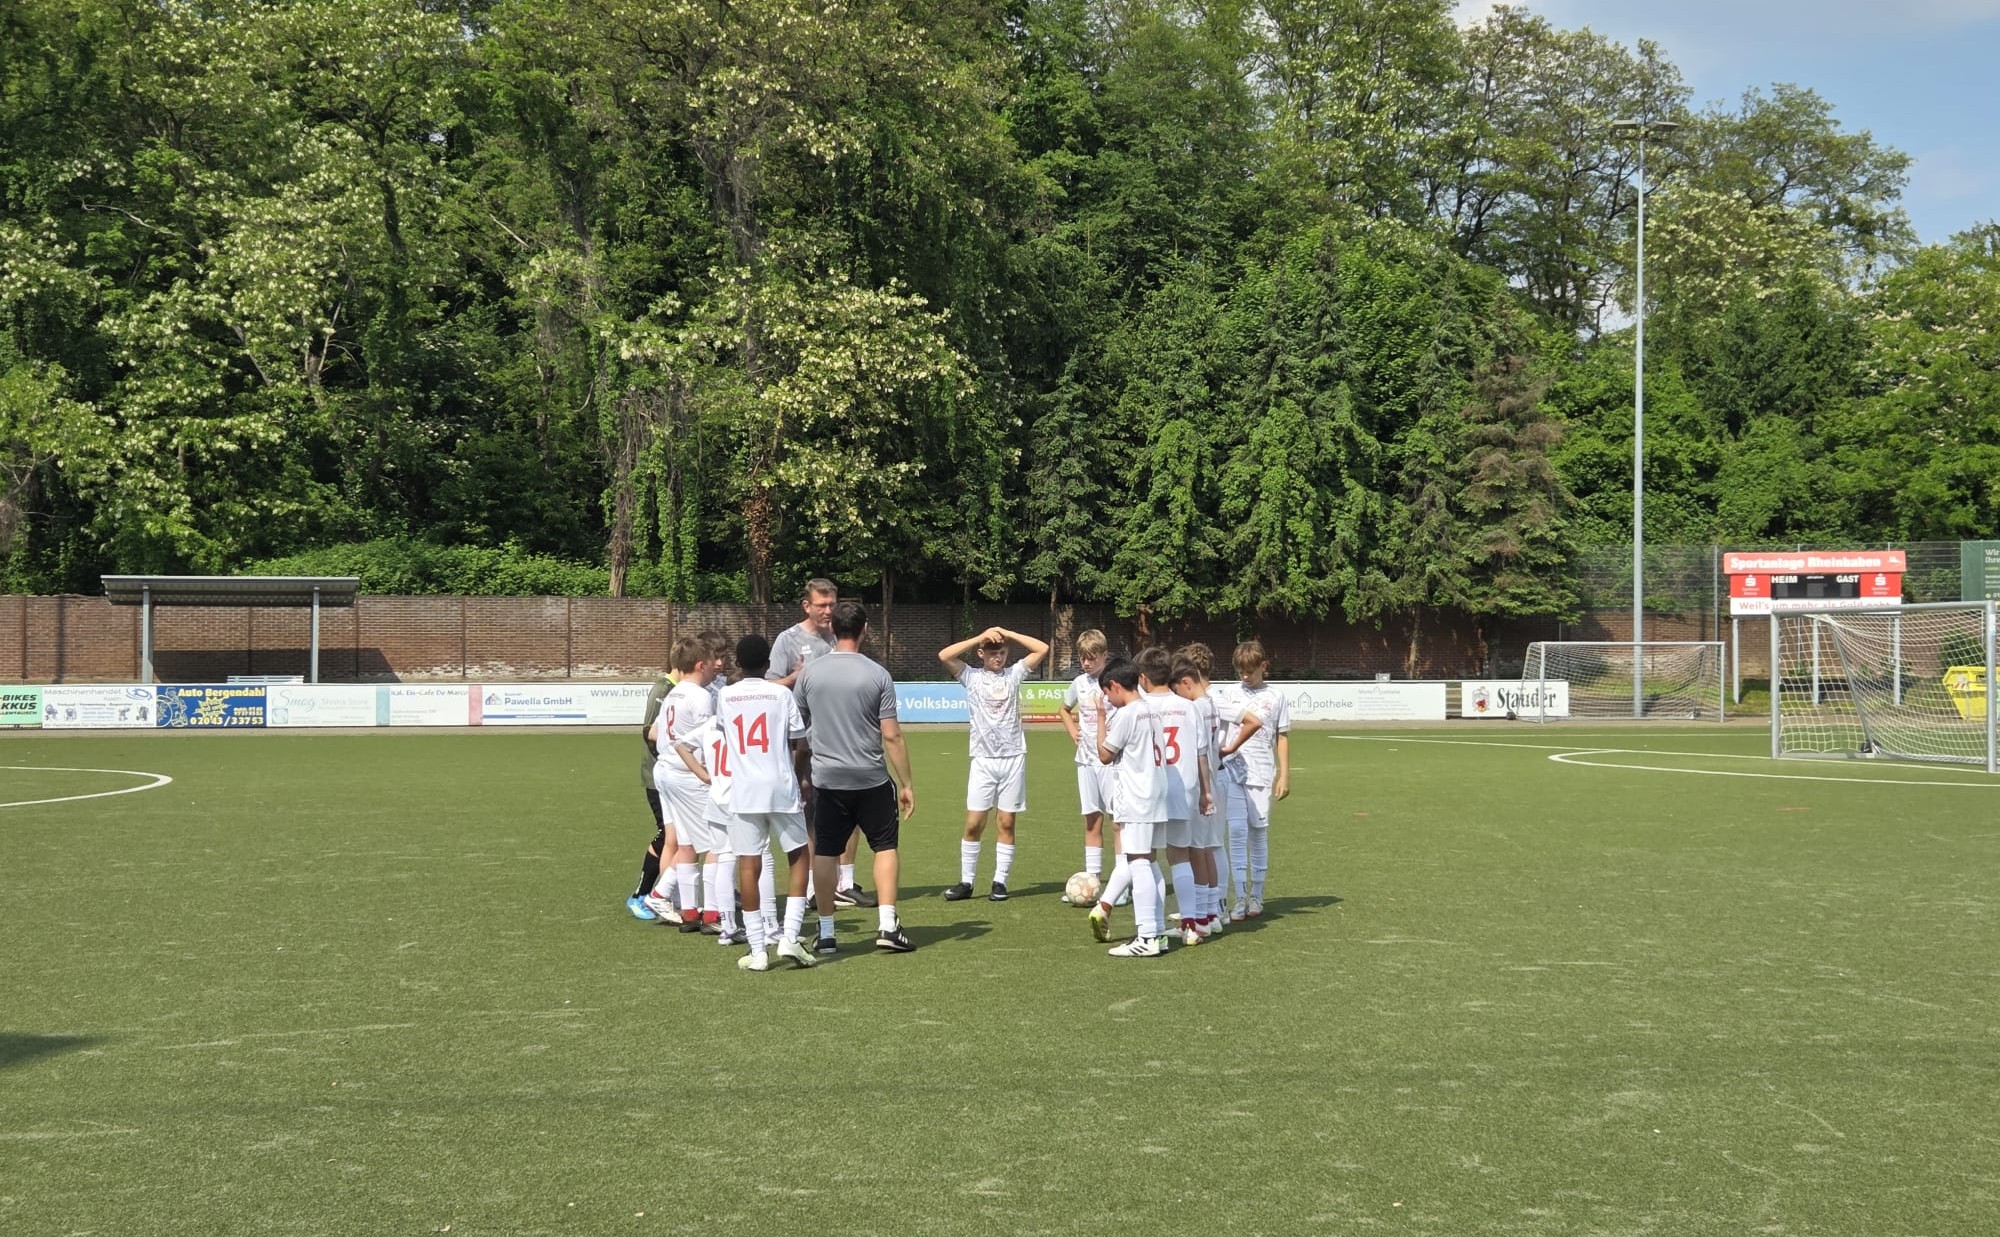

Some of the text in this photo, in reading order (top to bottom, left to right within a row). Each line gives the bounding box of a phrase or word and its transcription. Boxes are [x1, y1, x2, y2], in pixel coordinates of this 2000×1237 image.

[1730, 555, 1882, 571] Sportanlage Rheinbaben
[1771, 575, 1798, 584] HEIM
[1836, 574, 1860, 583] GAST
[177, 687, 266, 699] Auto Bergendahl
[1026, 688, 1035, 699] &
[504, 697, 541, 705] Pawella
[543, 697, 573, 705] GmbH
[732, 712, 769, 754] 14
